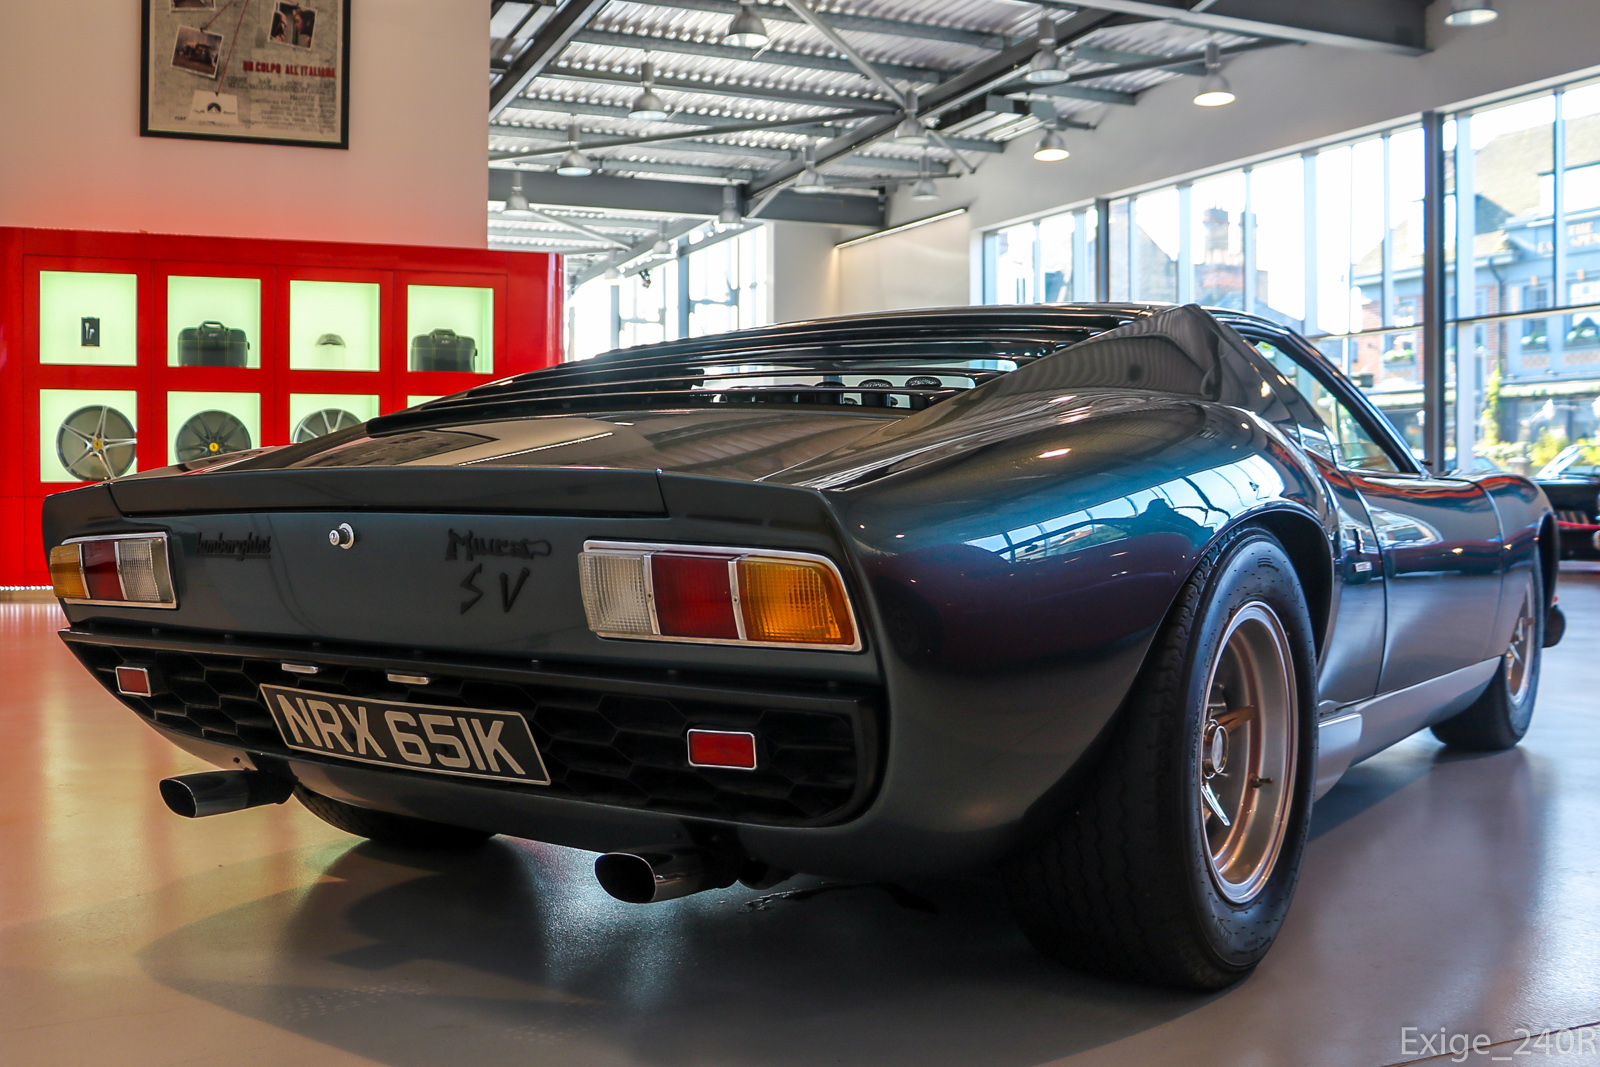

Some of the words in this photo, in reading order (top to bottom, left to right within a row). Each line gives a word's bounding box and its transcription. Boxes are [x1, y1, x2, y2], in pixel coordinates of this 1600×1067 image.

[255, 61, 281, 74] COLPO
[276, 694, 387, 758] NRX
[384, 710, 526, 775] 651K
